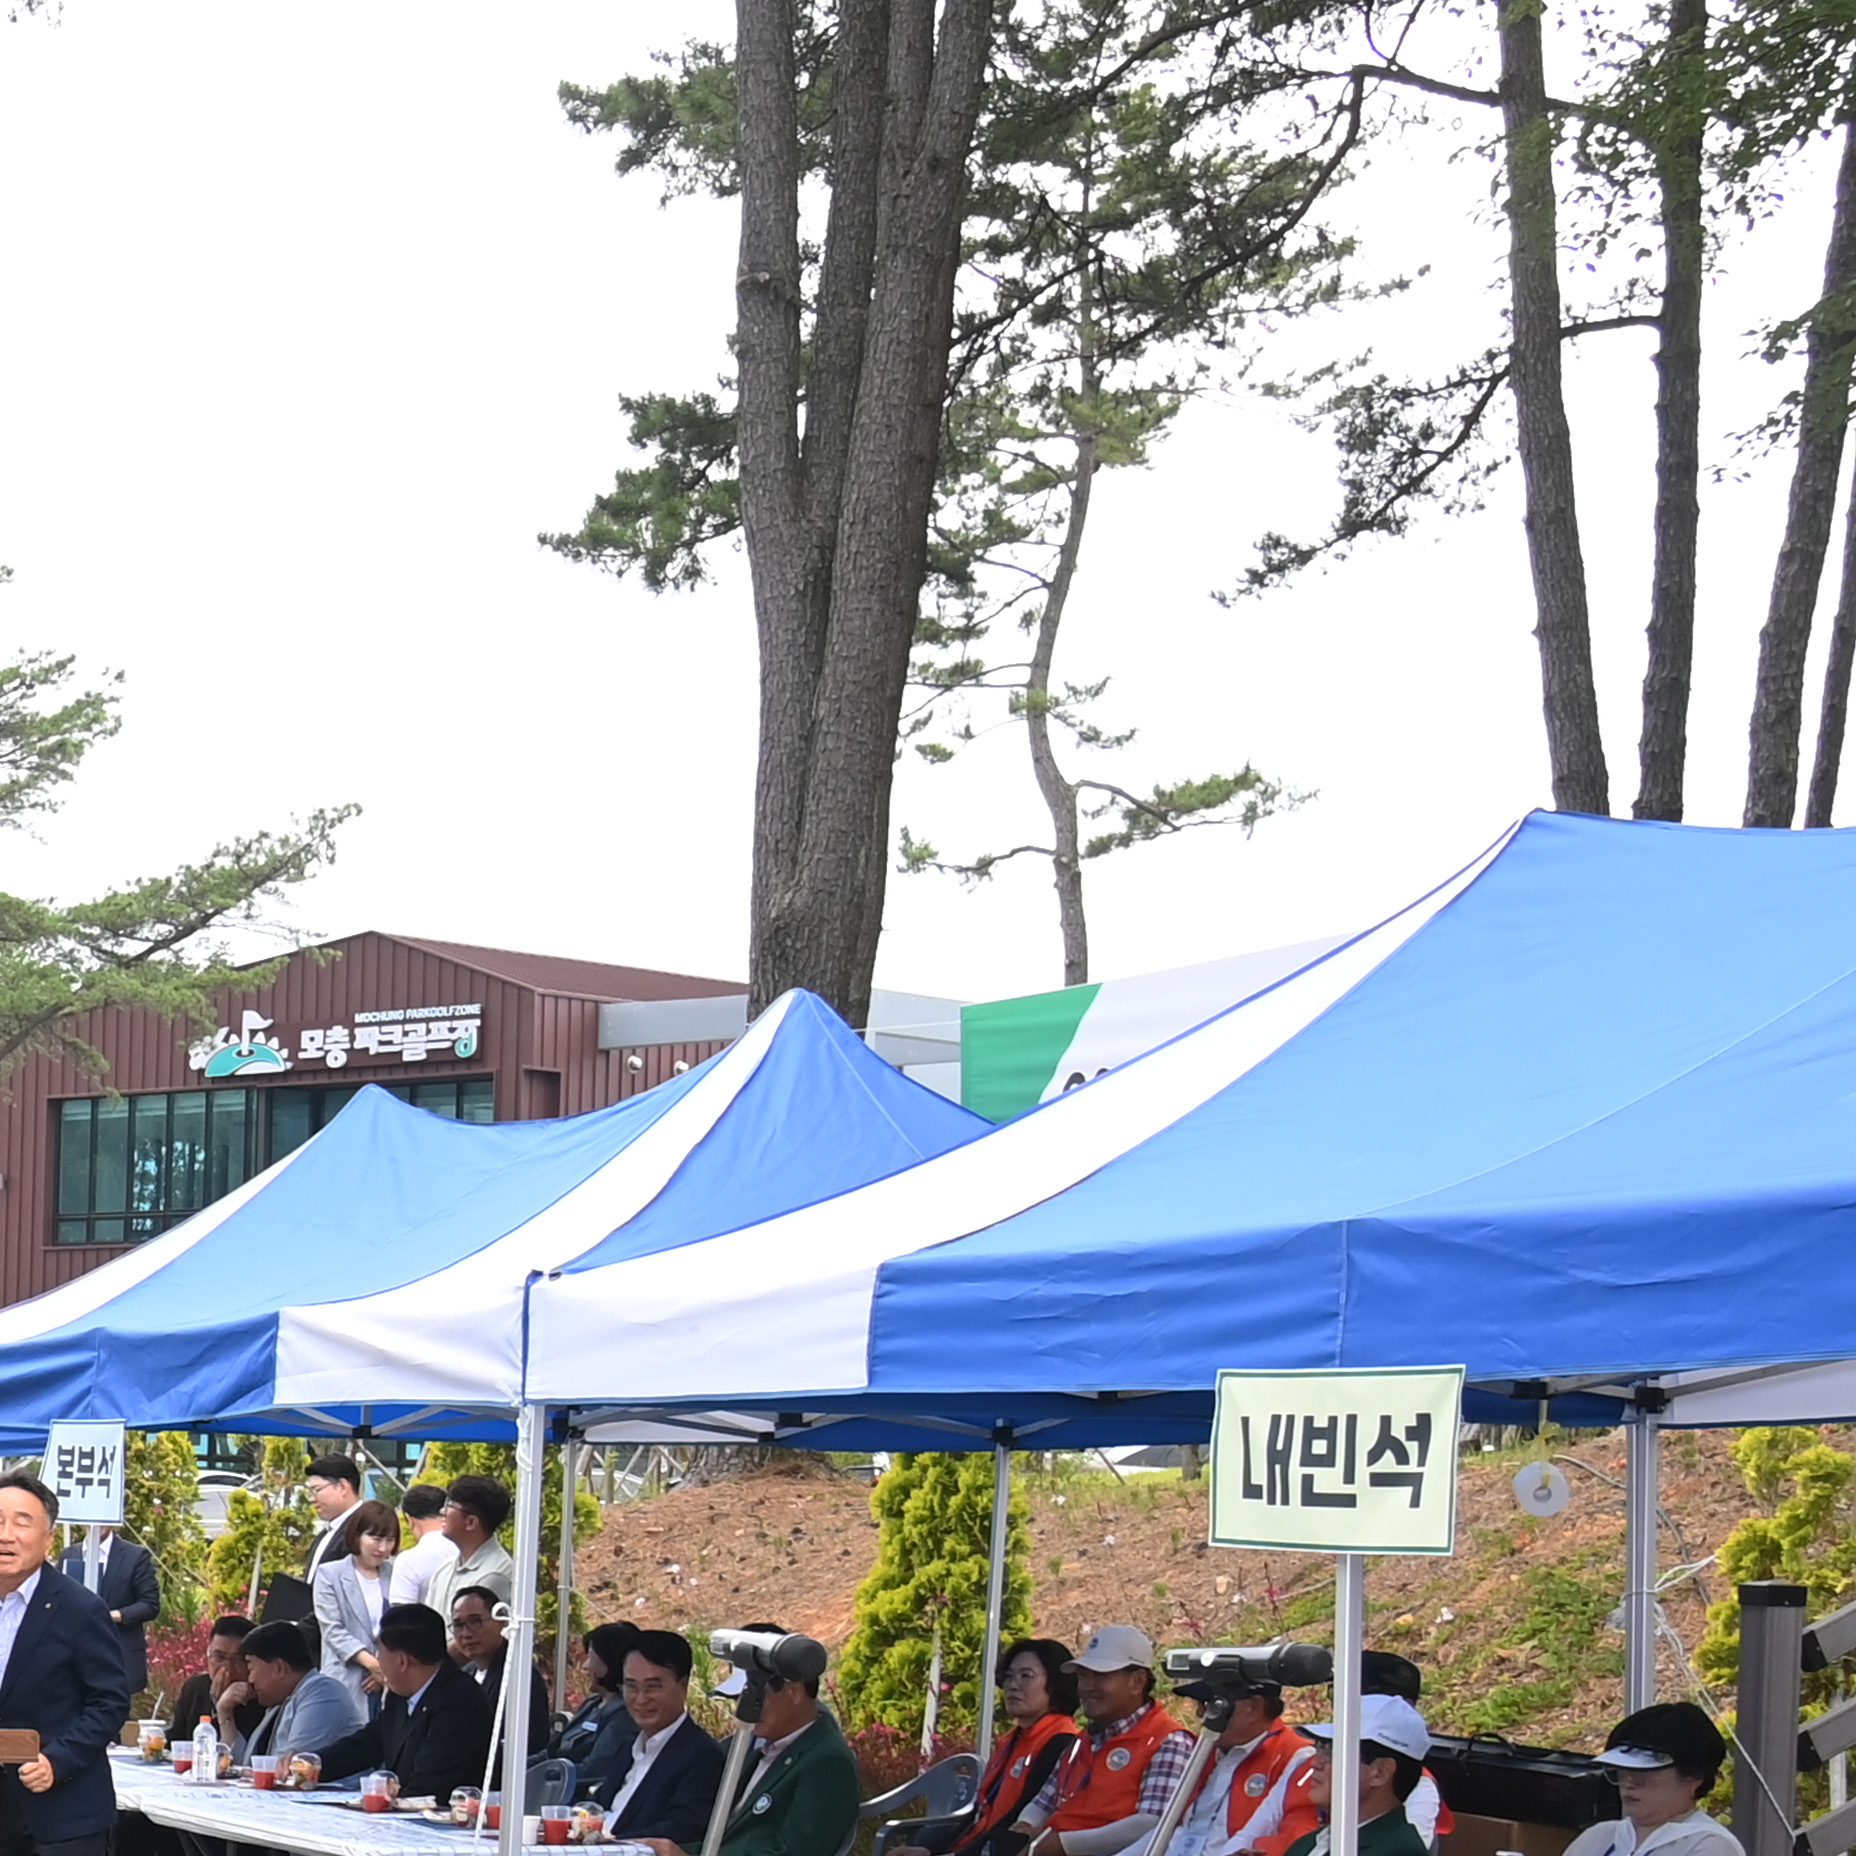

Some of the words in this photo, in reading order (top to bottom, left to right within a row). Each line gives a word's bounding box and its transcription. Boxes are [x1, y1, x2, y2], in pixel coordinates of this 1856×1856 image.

[354, 1006, 404, 1024] MOCHUNG
[298, 1025, 351, 1069] 모충
[353, 1019, 482, 1062] 파크골프장
[56, 1445, 117, 1499] 본부석
[1241, 1412, 1432, 1508] 내빈석
